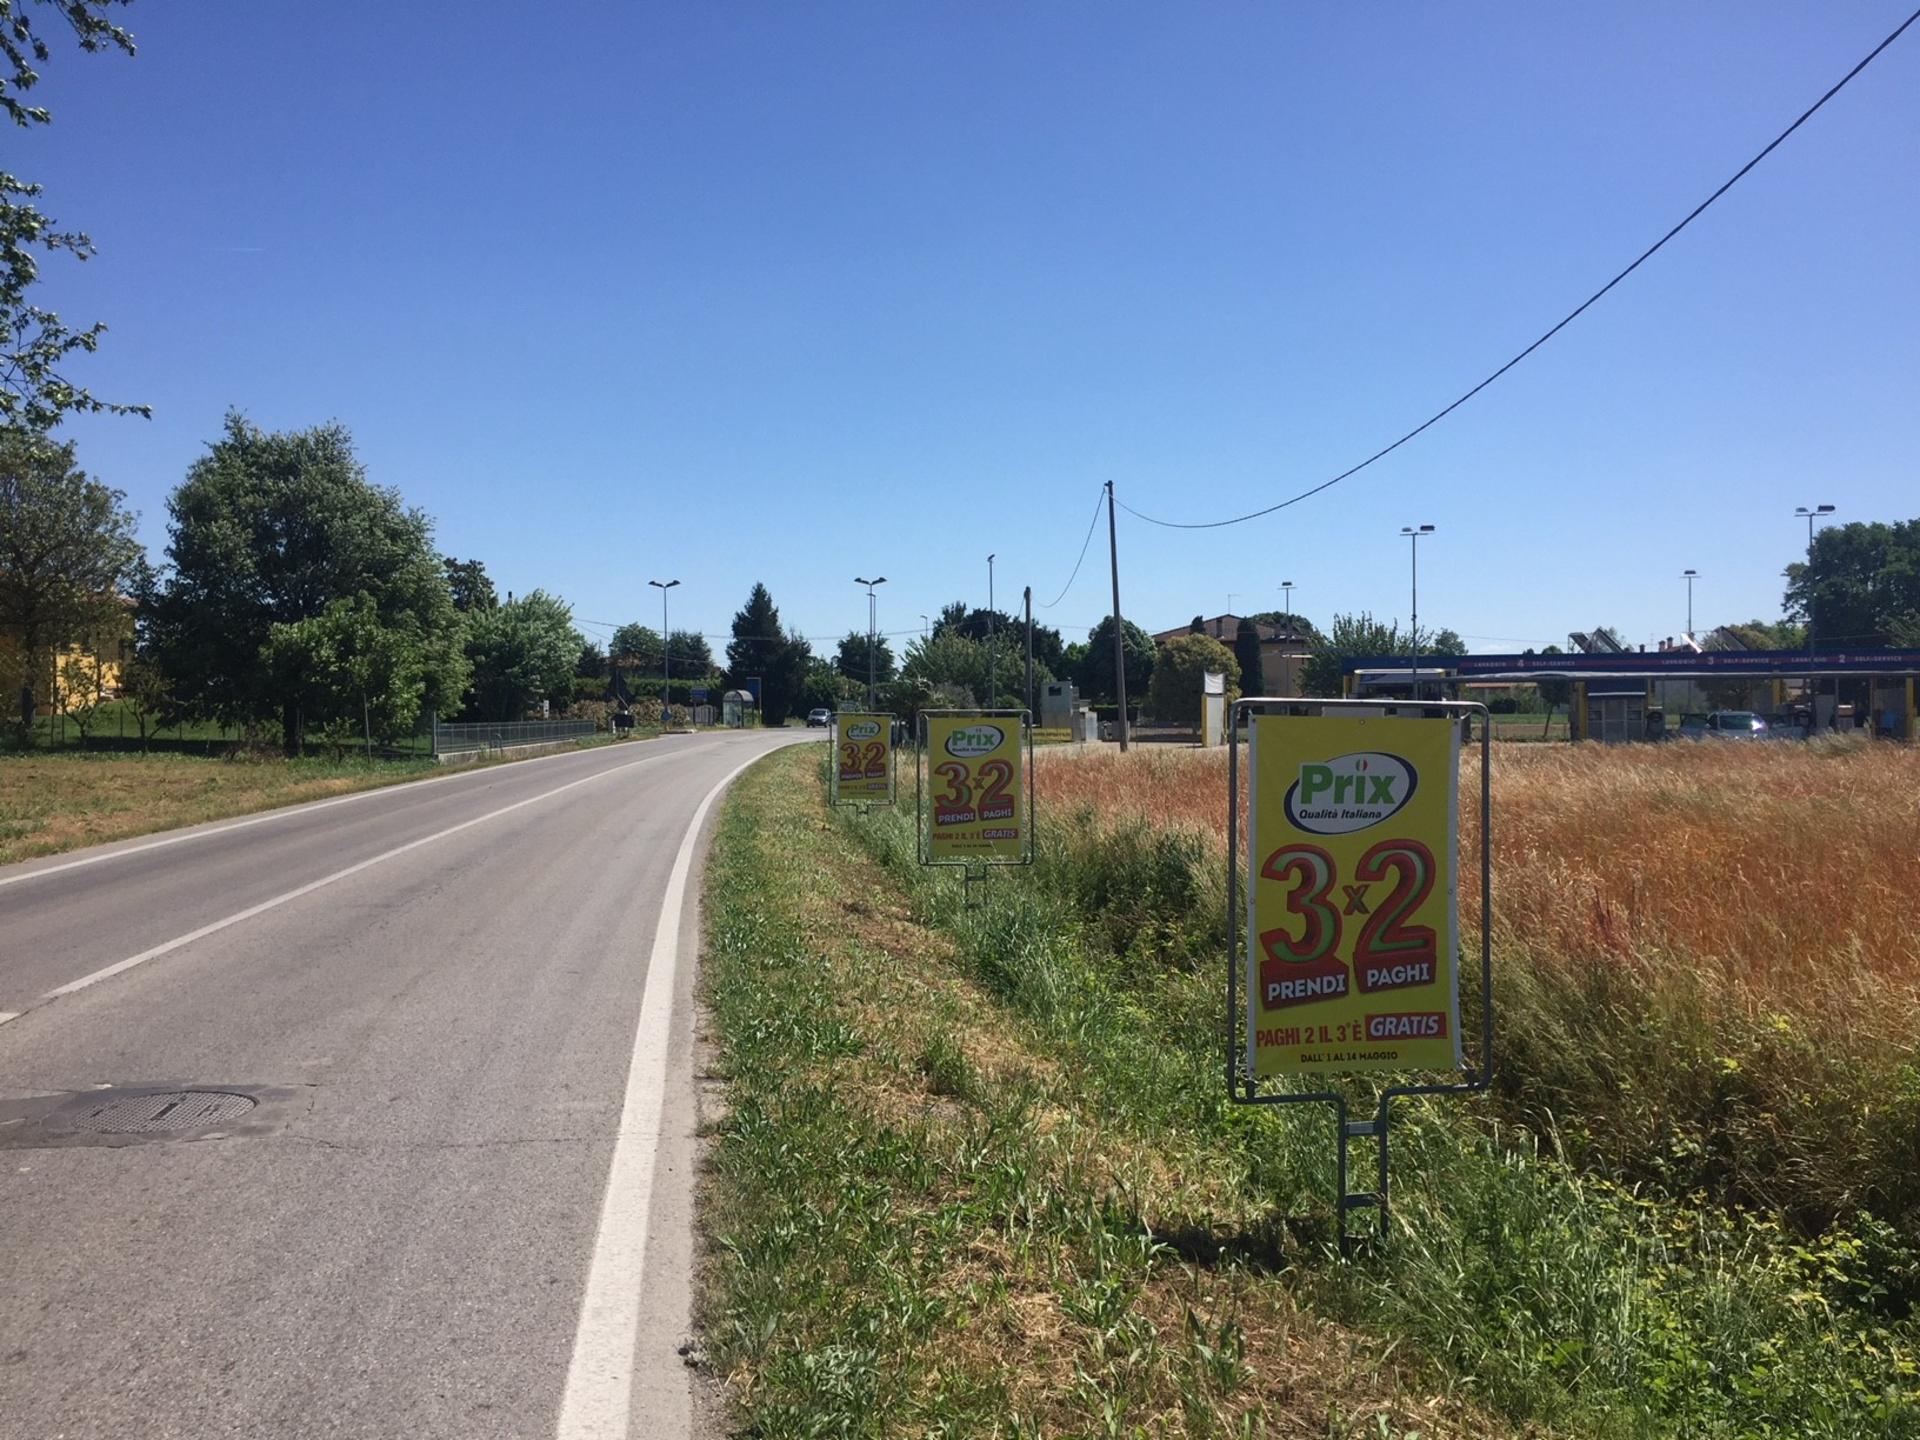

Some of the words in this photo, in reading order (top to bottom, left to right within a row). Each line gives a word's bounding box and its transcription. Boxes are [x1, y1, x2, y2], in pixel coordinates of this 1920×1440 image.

[952, 728, 995, 746] Prix
[1300, 759, 1397, 805] Prix
[938, 813, 974, 823] PRENDI
[983, 809, 1012, 819] PAGHI
[1299, 808, 1338, 819] Qualità
[1340, 808, 1382, 819] Italiana
[984, 830, 1015, 838] GRATIS
[1268, 974, 1346, 1001] PRENDI
[1367, 963, 1430, 987] PAGHI
[1256, 1027, 1300, 1047] PAGHI
[1305, 1027, 1315, 1044] 2
[1319, 1026, 1333, 1043] IL
[1370, 1016, 1439, 1036] GRATIS
[1301, 1053, 1325, 1063] DALL'
[1326, 1053, 1331, 1062] 1
[1333, 1052, 1345, 1061] AL
[1346, 1052, 1357, 1061] 14
[1359, 1051, 1398, 1061] MAGGIO
